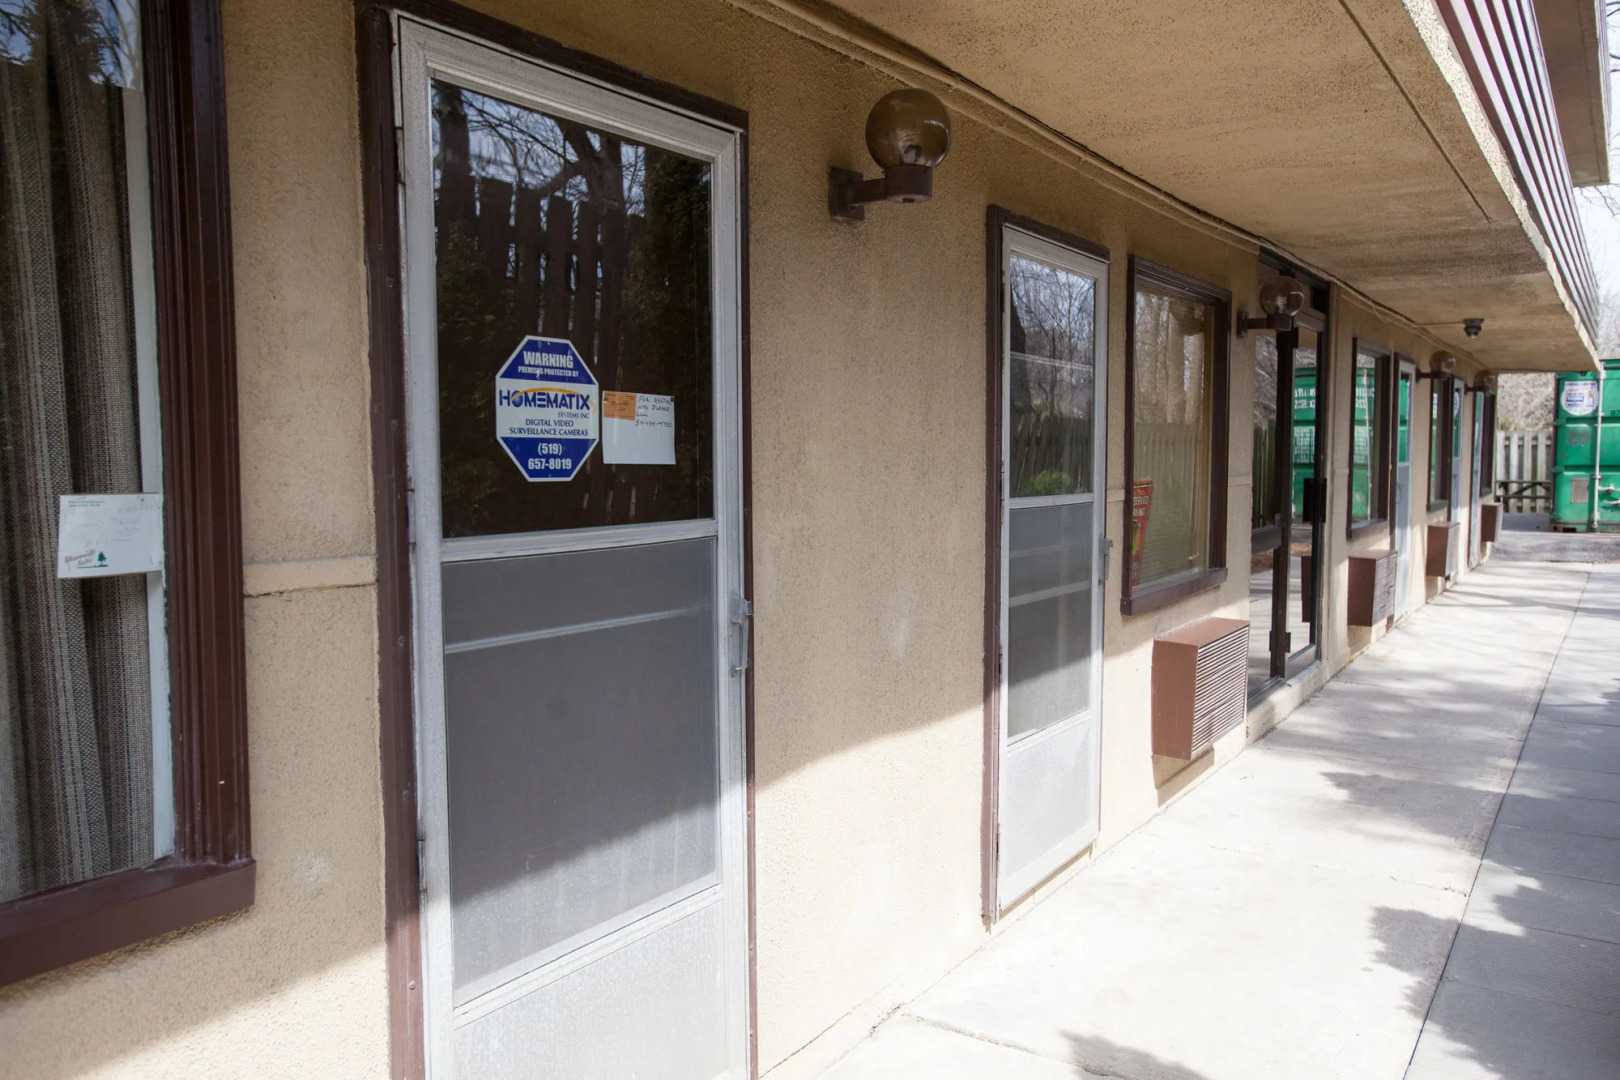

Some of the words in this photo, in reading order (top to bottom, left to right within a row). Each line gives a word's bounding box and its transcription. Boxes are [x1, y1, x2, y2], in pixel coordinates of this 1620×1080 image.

[523, 350, 574, 369] WARNING
[518, 366, 544, 375] PREMISES
[544, 368, 572, 377] PROTECTED
[499, 389, 591, 411] HOMEMATIX
[525, 419, 552, 427] DIGITAL
[554, 419, 574, 427] VIDEO
[509, 427, 557, 436] SURVEILLANCE
[558, 428, 589, 436] CAMERAS
[537, 442, 563, 456] (519)
[528, 458, 572, 470] 657-8019
